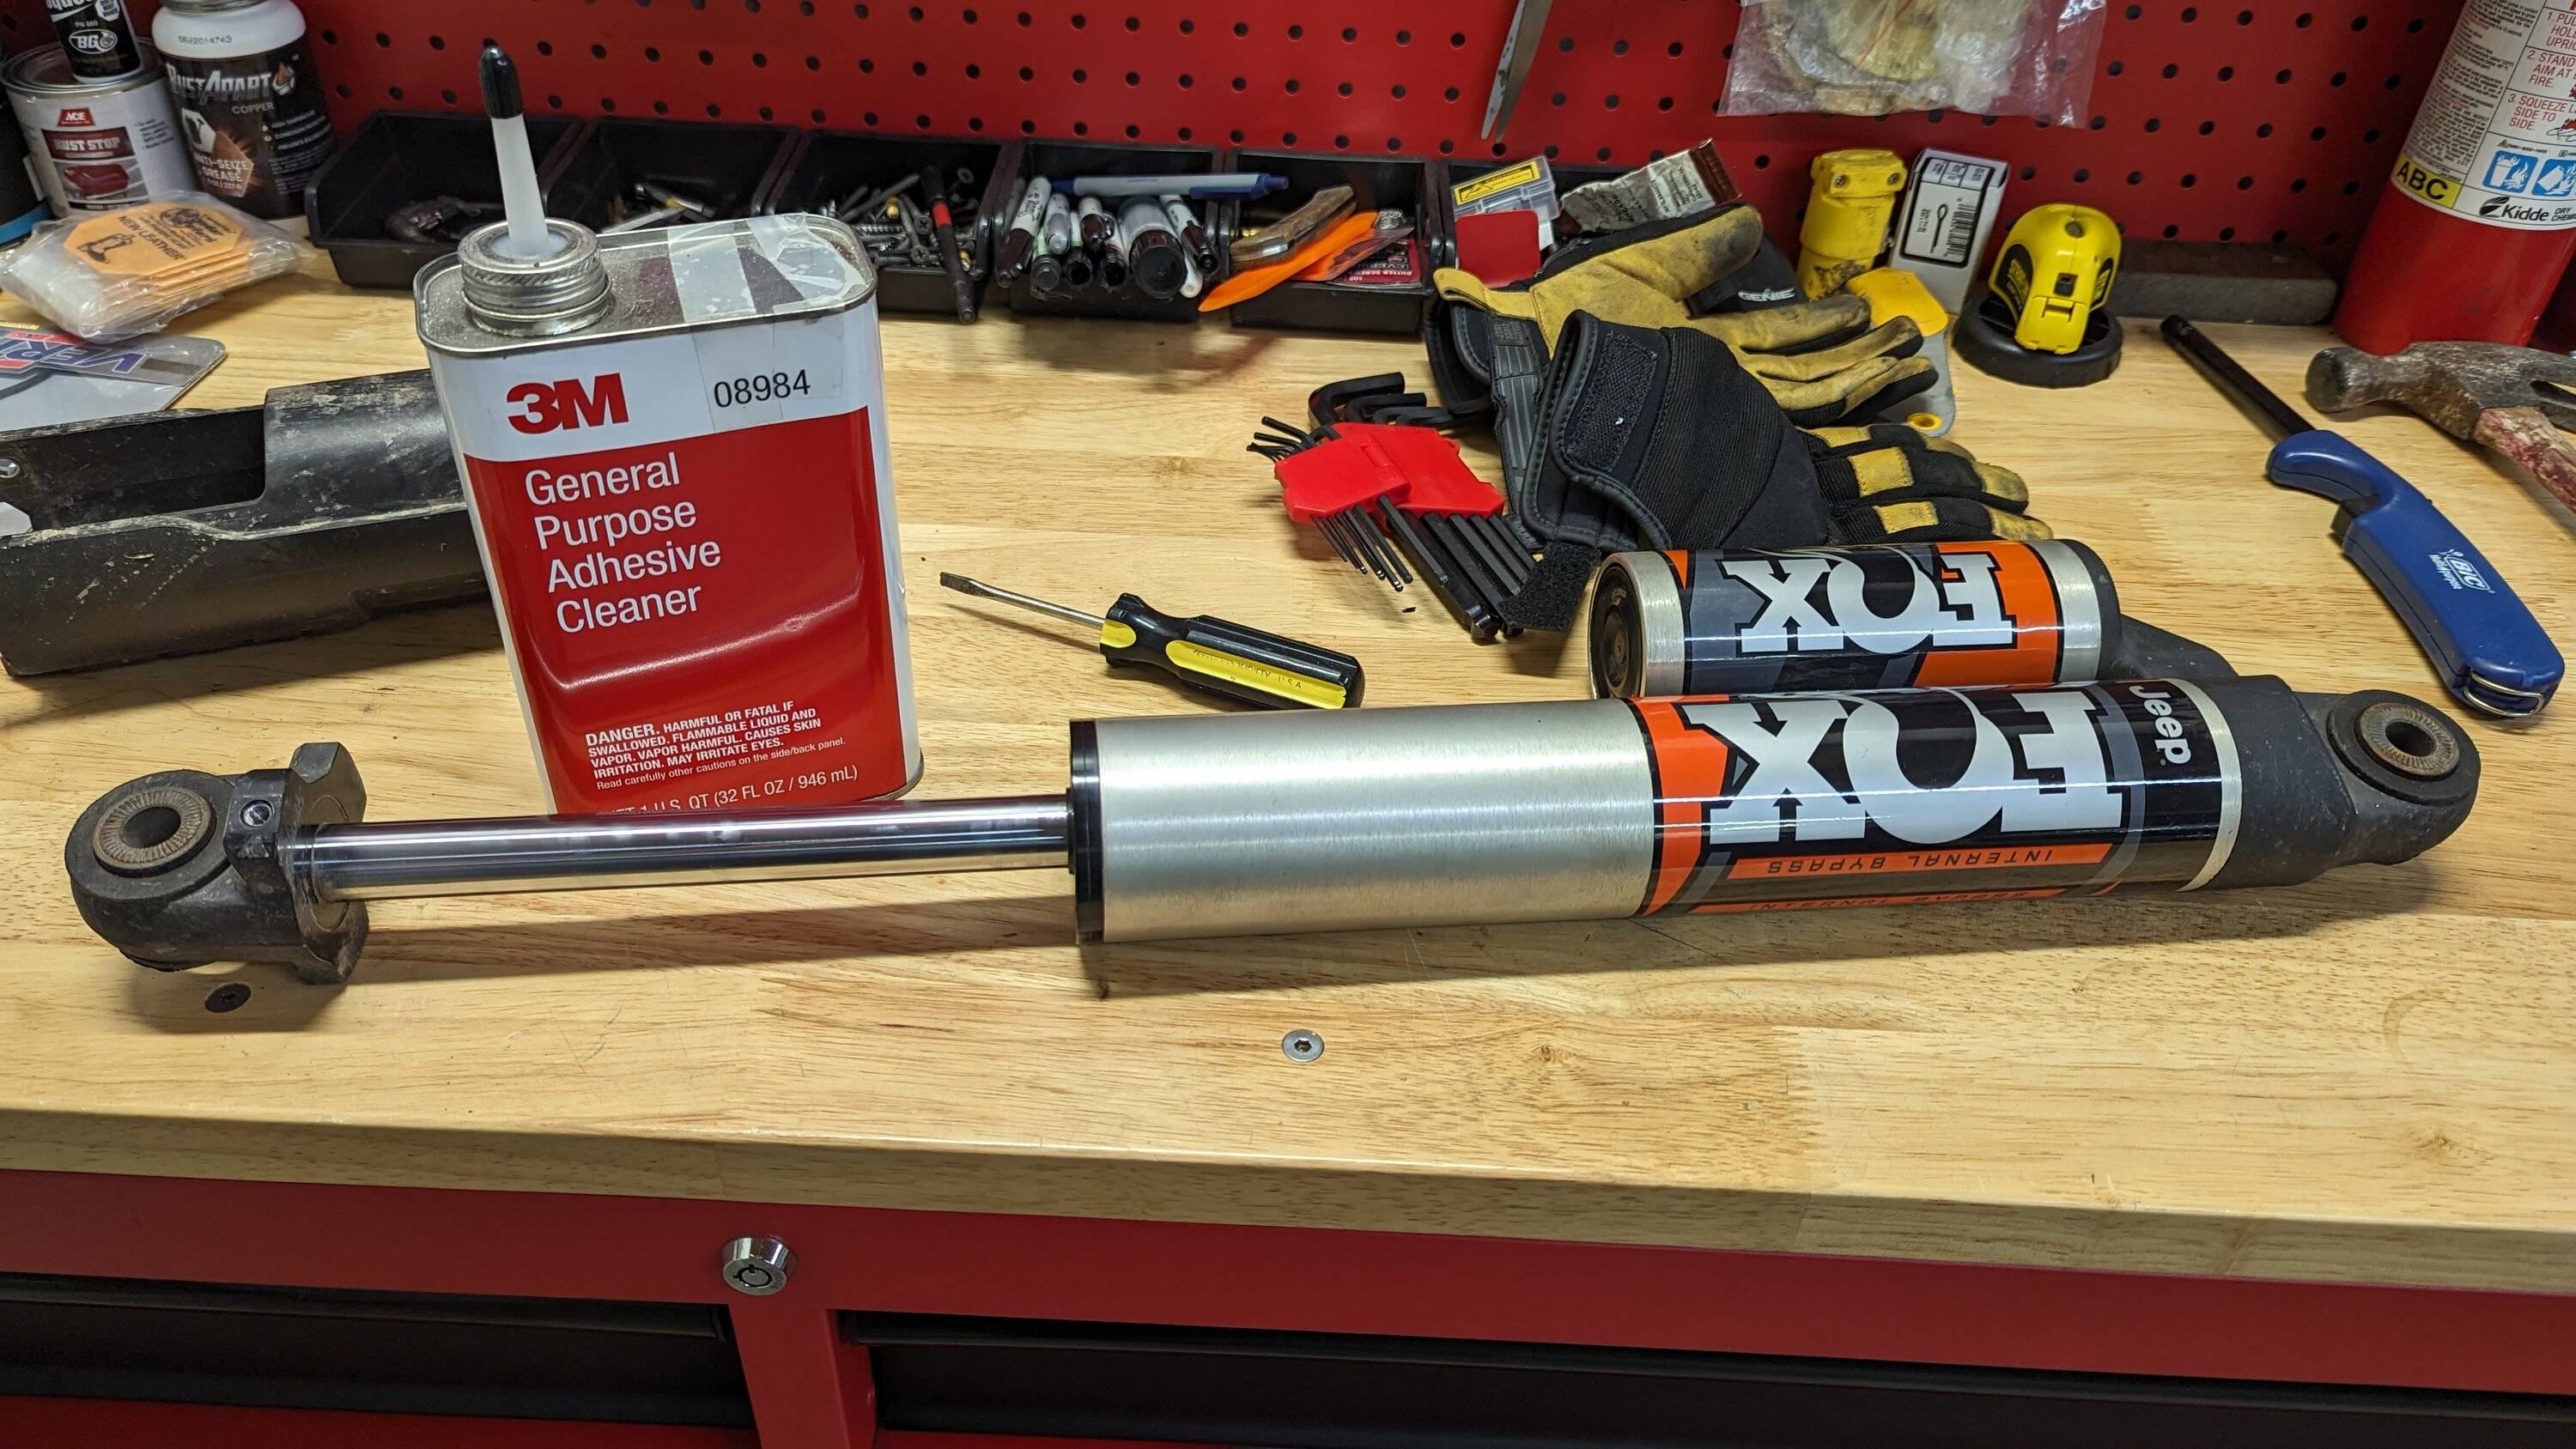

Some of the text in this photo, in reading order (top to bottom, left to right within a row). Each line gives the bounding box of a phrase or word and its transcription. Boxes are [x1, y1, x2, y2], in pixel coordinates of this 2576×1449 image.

[2533, 64, 2573, 78] AIM AT
[64, 112, 86, 121] ACE
[231, 102, 274, 114] COPPER
[2513, 106, 2556, 122] SIDE TO
[2518, 95, 2567, 112] SQUEEZE
[87, 136, 120, 150] STOP
[2397, 160, 2449, 200] ABC
[2501, 203, 2549, 221] Kidde
[117, 215, 137, 232] NEW
[137, 229, 187, 260] LEATHER
[0, 340, 148, 374] VER
[506, 372, 629, 434] 3M
[713, 369, 811, 408] 08984
[525, 452, 681, 506] General
[534, 501, 696, 550] Purpose
[547, 540, 721, 594] Adhesive
[2448, 559, 2487, 589] BIC
[556, 585, 702, 634] Cleaner
[1726, 548, 2014, 654] FOX
[586, 700, 794, 747] DANGER. HARMFUL OR FATAL IF
[588, 707, 817, 758] SWALLOWED. FLAMMABLE LIQUID AND
[590, 718, 822, 769] VAPOR. VAPOR HARMFUL. CAUSES SKIN
[2129, 686, 2191, 764] Jeep
[593, 737, 784, 780] IRRITATION. MAY IRRITATE EYES.
[597, 737, 847, 791] Read carefully other cautions on the side/back panel.
[1685, 688, 2123, 844] FOX
[689, 793, 709, 810] QT
[714, 788, 738, 809] (32
[741, 784, 762, 801] FL
[763, 779, 786, 797] OZ
[797, 772, 828, 790] 946
[830, 764, 859, 784] mL)
[1766, 849, 2053, 875] INTERNAL BYPASS
